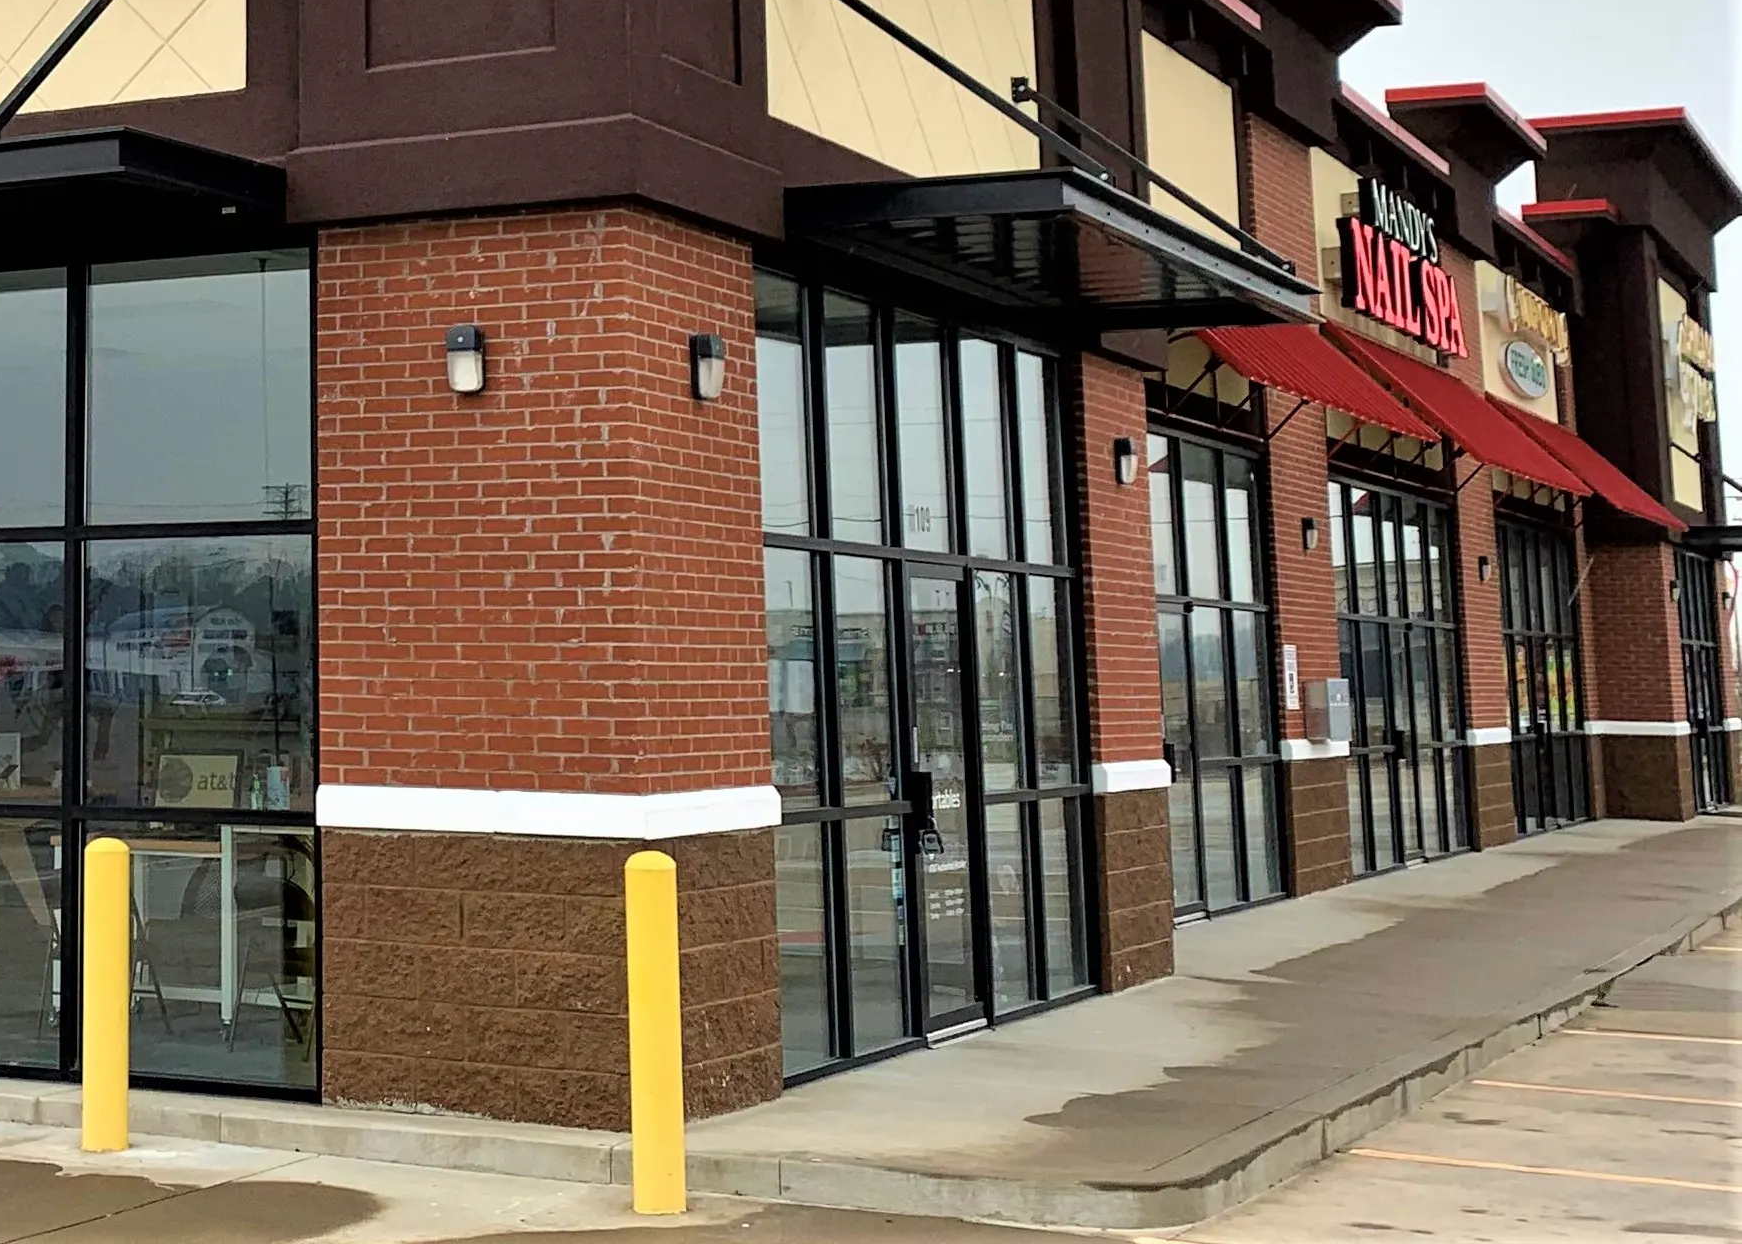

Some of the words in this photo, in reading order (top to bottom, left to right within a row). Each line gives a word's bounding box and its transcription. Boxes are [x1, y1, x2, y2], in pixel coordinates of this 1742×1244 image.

[1370, 177, 1439, 264] MANDY'S
[1350, 216, 1422, 336] NAIL
[1421, 258, 1469, 358] SPA
[197, 771, 237, 791] at&t
